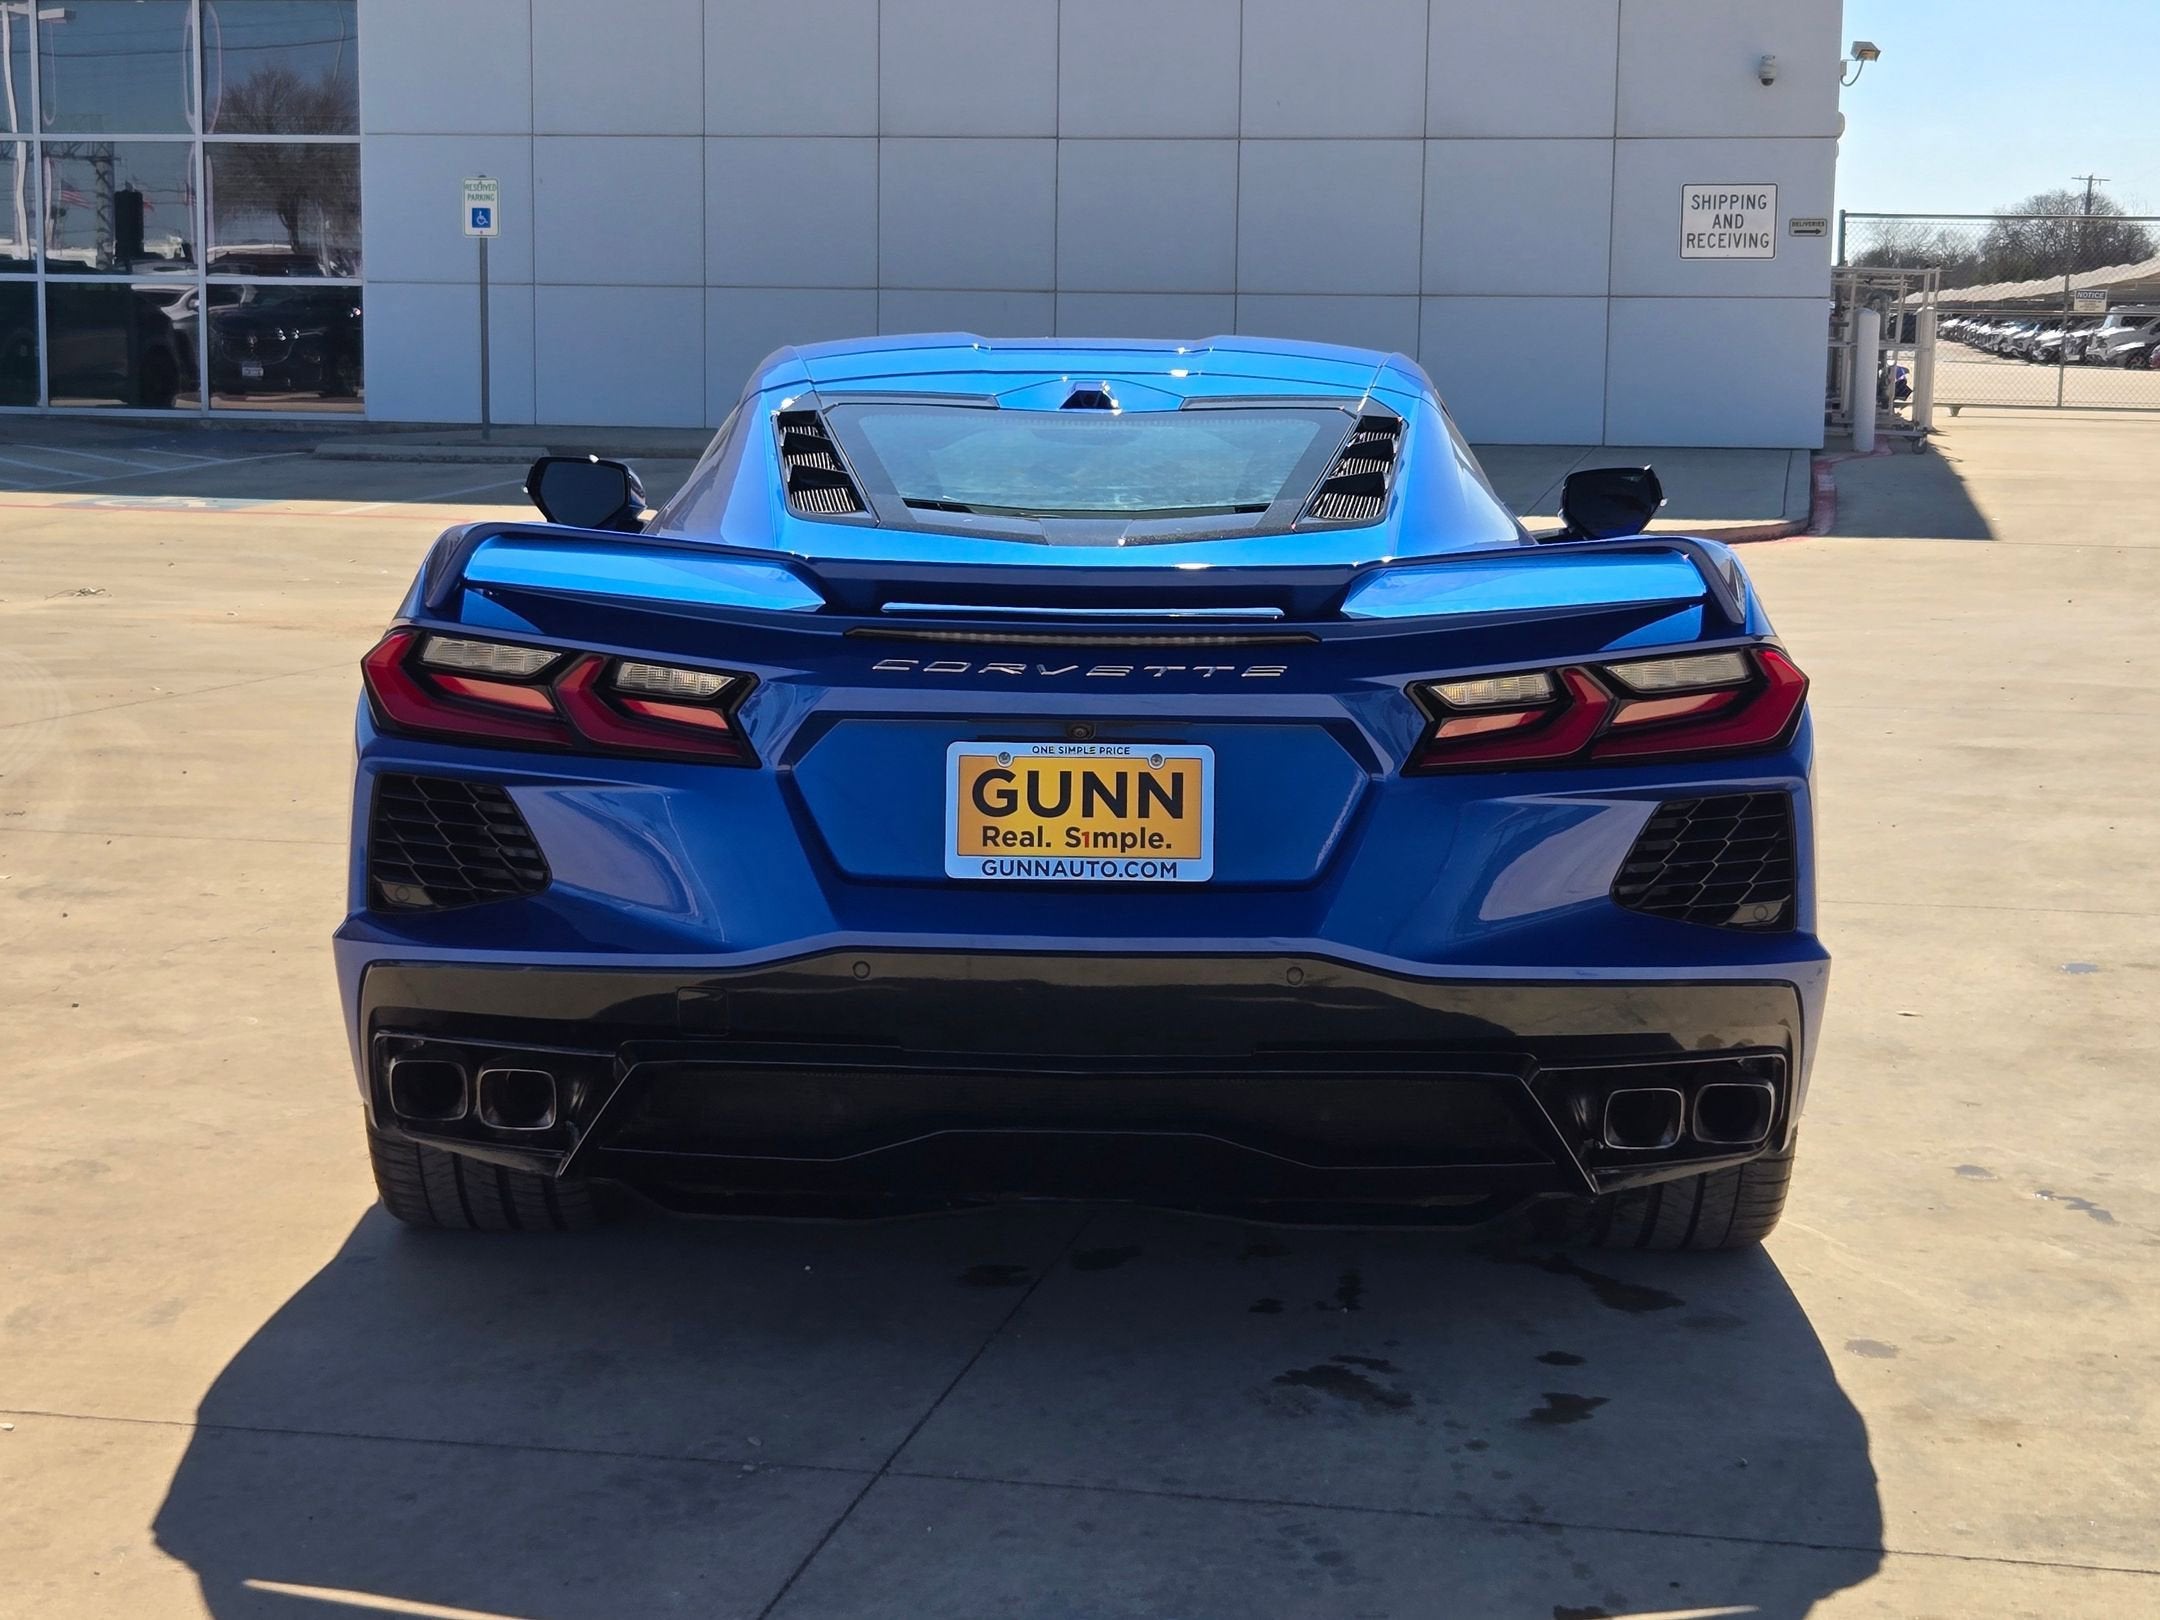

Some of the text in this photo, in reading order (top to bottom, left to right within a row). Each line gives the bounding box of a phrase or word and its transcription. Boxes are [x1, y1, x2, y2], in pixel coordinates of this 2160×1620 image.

[467, 193, 495, 201] PARKING
[1691, 194, 1767, 210] SHIPPING
[1712, 213, 1744, 229] AND
[1686, 232, 1770, 249] RECEIVING
[2076, 291, 2105, 299] NOTICE
[872, 658, 1288, 678] CORVETTE
[1032, 745, 1131, 755] ONE SIMPLE PRICE
[972, 768, 1184, 820] GUNN
[982, 825, 1052, 849] Real.
[981, 859, 1178, 879] GUNNAUTO.COM
